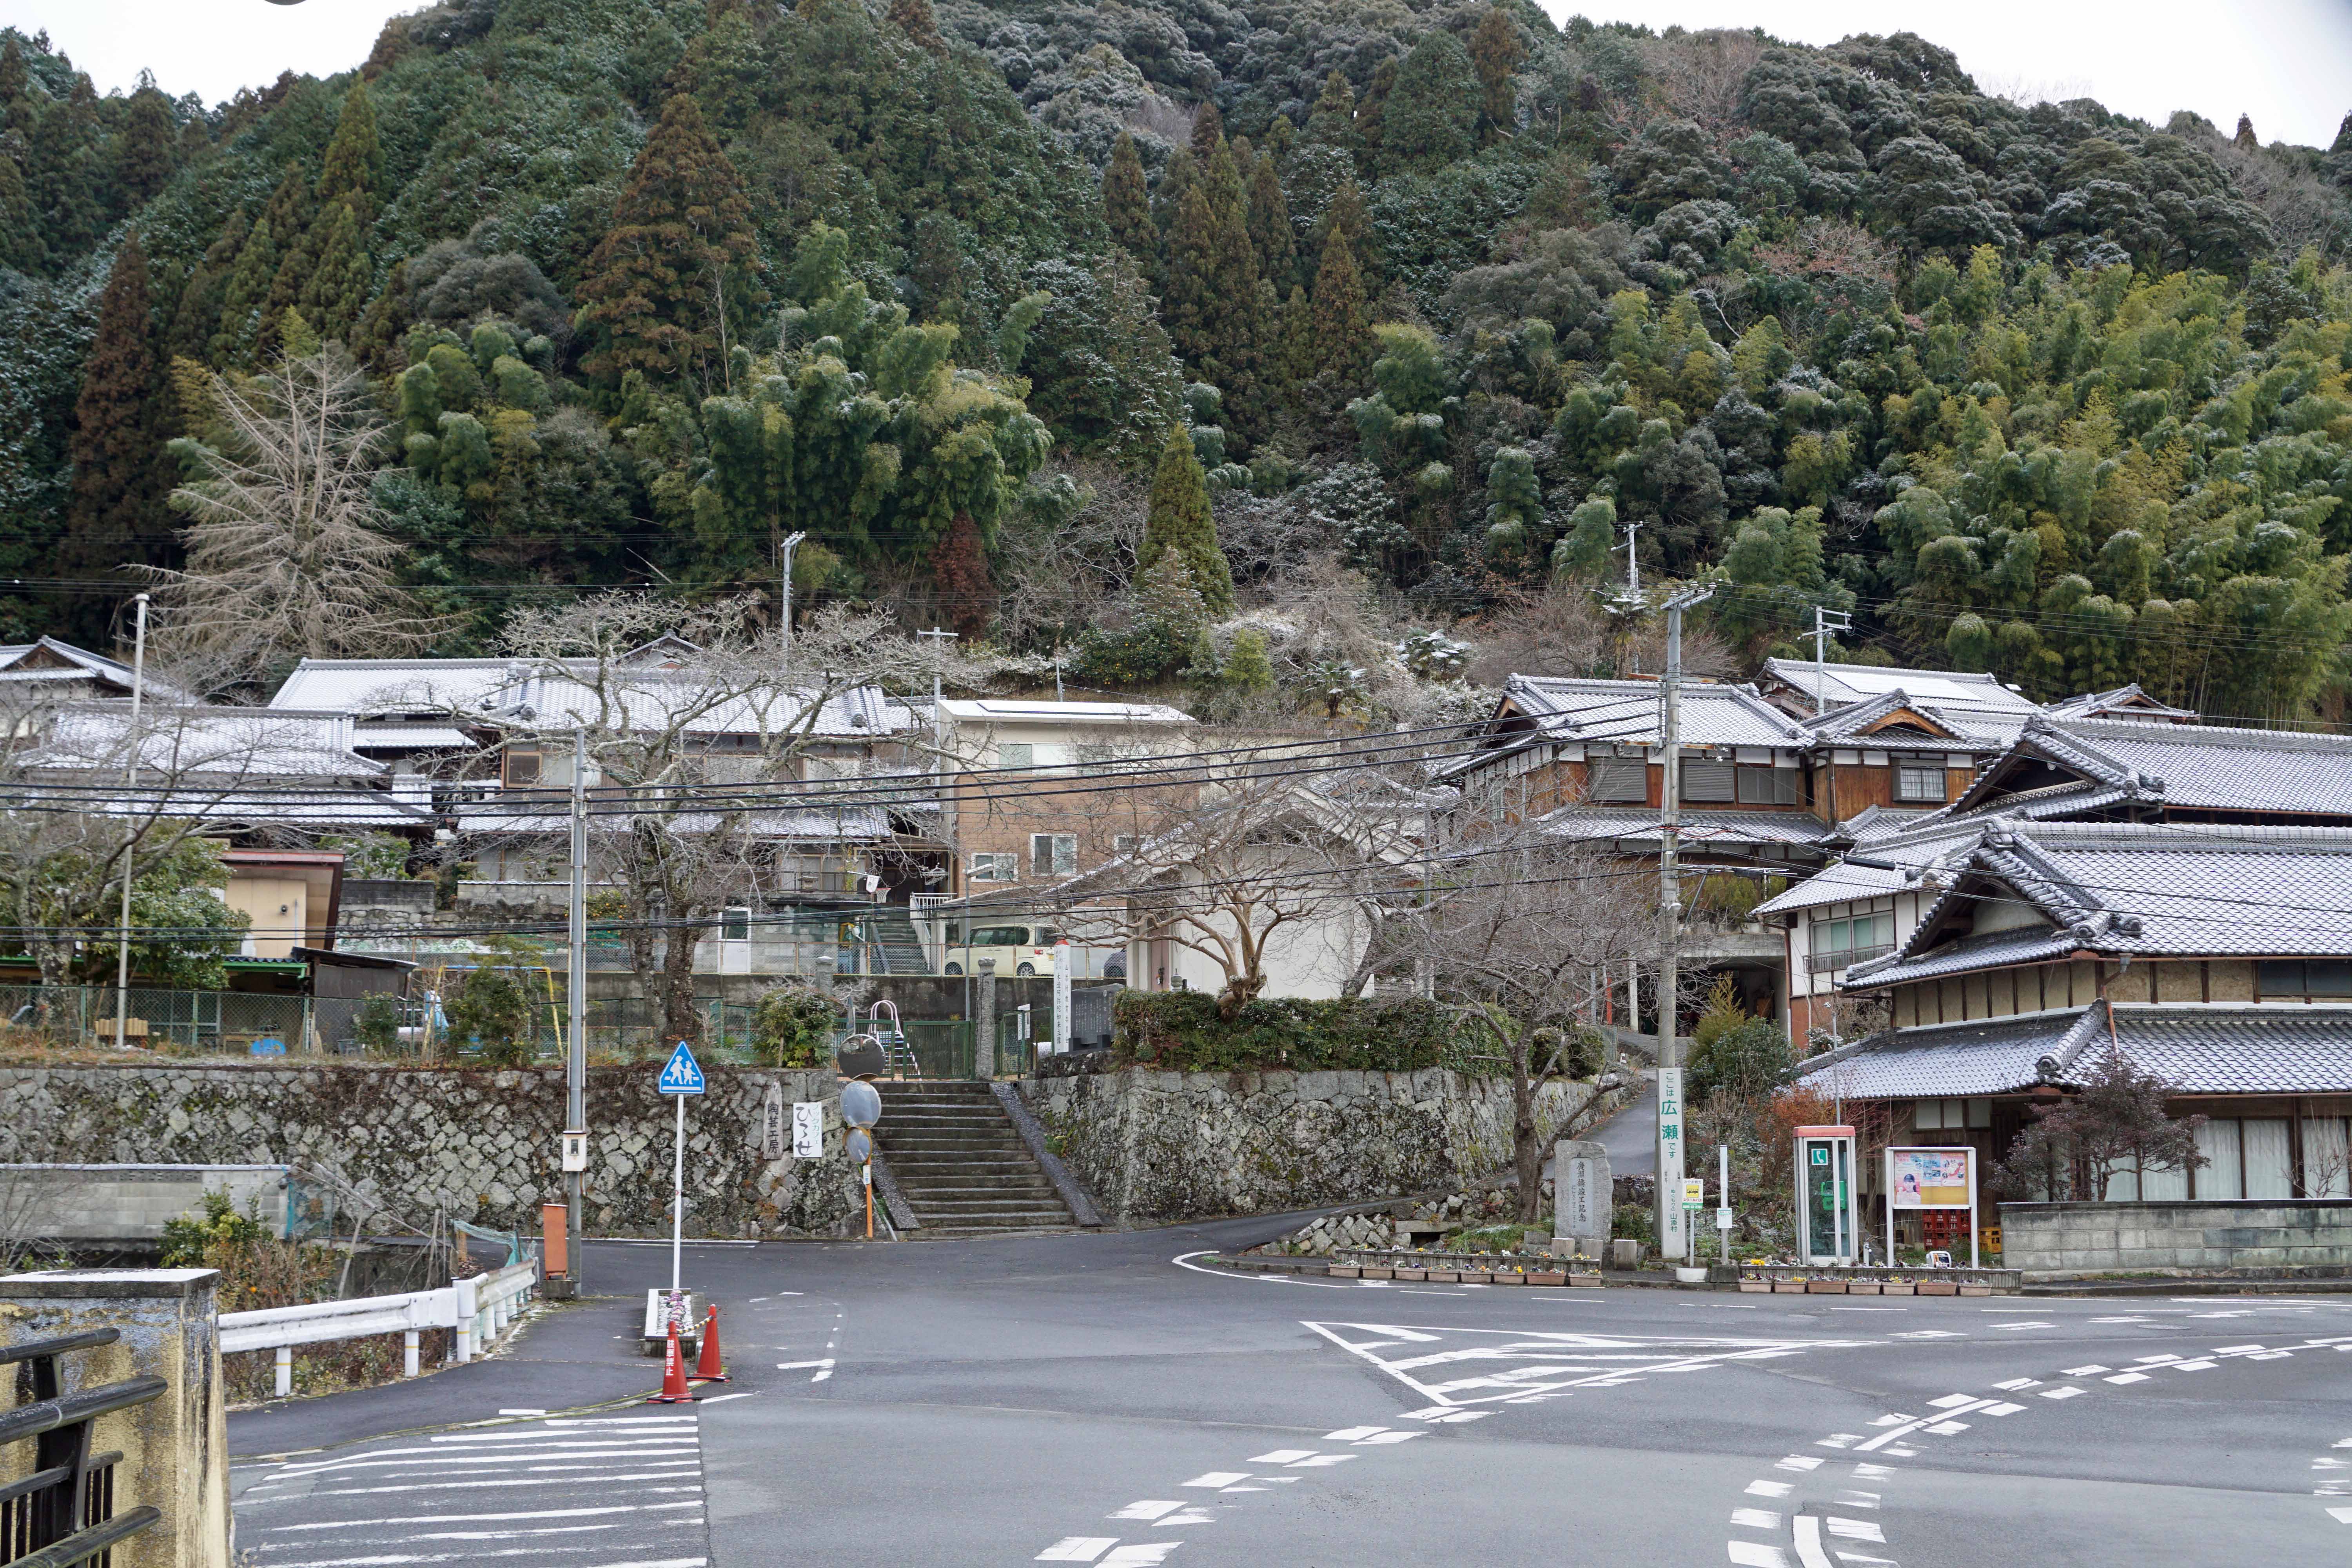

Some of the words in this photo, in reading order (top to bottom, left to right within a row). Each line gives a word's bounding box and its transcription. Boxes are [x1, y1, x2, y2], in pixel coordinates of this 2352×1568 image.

[768, 1103, 779, 1154] 陶芸工房
[795, 1106, 813, 1156] ひろせ
[1661, 1073, 1679, 1158] ここは広瀬です
[666, 1339, 675, 1376] 駐車禁止
